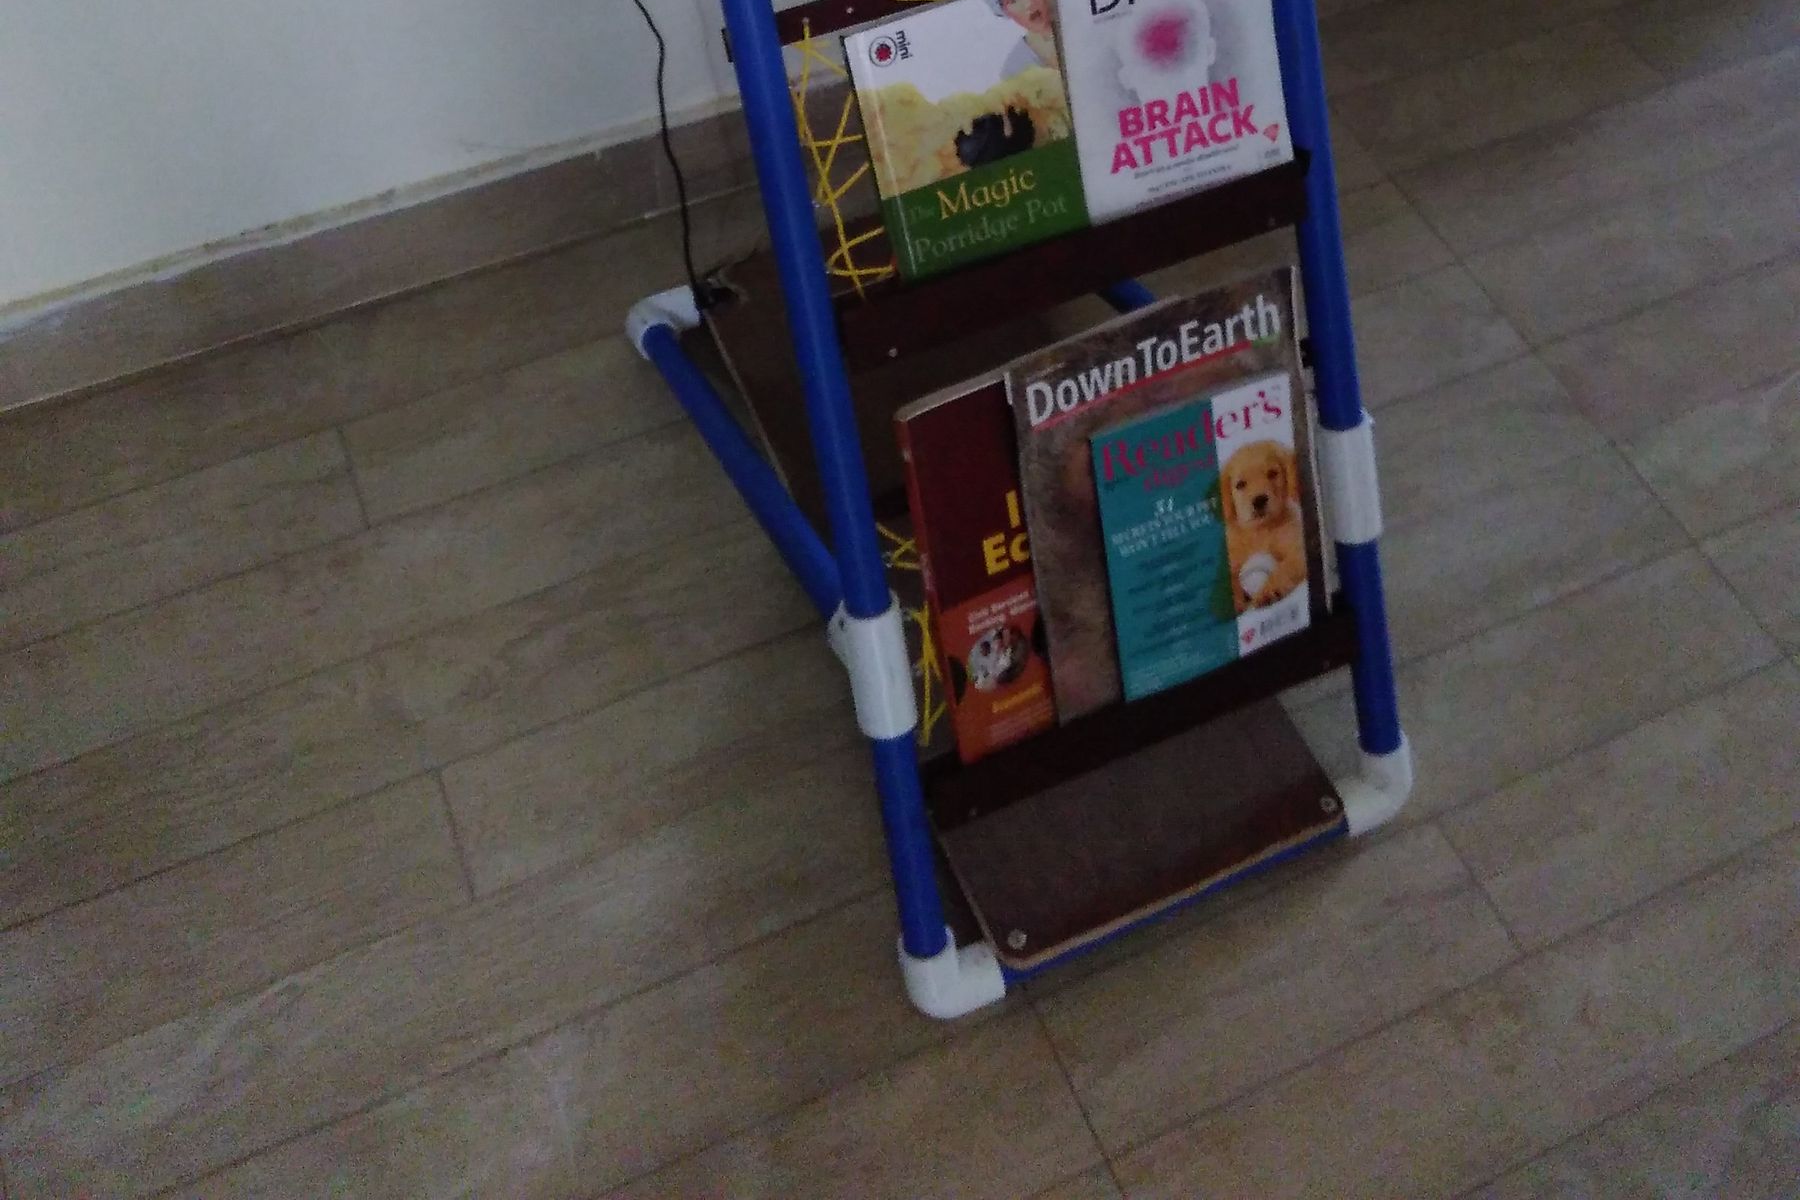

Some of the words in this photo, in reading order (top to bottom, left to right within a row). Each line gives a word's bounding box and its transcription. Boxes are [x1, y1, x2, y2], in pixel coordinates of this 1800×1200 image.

[896, 30, 913, 60] mini
[1110, 104, 1259, 175] ATTACK
[1118, 77, 1240, 139] BRAIN
[937, 168, 1037, 221] Magic
[915, 215, 1019, 264] Porridge
[1025, 196, 1068, 225] Pot
[1025, 294, 1281, 427] DownToEarth
